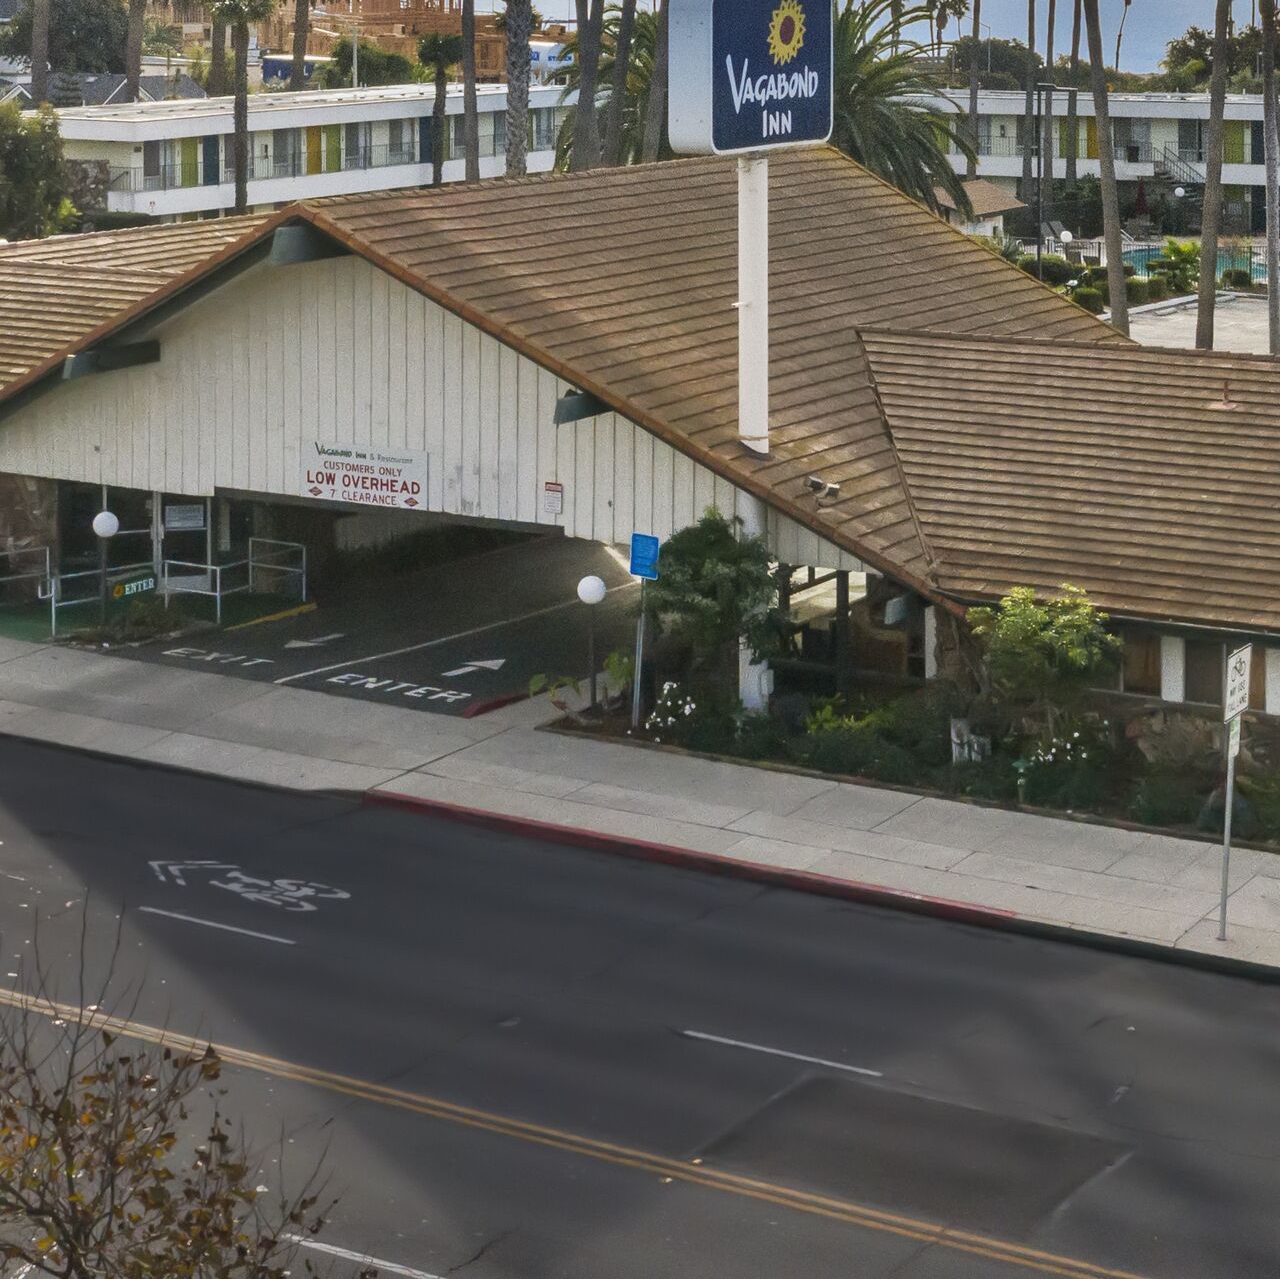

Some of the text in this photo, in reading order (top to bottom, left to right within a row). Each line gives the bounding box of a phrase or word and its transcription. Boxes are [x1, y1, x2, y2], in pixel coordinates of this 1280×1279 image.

[725, 53, 819, 115] VAGABOND
[762, 109, 792, 138] INN
[323, 460, 402, 477] CUSTOMERS ONLY
[306, 470, 336, 486] LOW
[342, 474, 421, 495] OVERHEAD
[341, 489, 397, 506] CLEARANCE
[124, 578, 155, 596] ENTER
[161, 647, 275, 667] EXIT
[326, 673, 472, 703] ENTER
